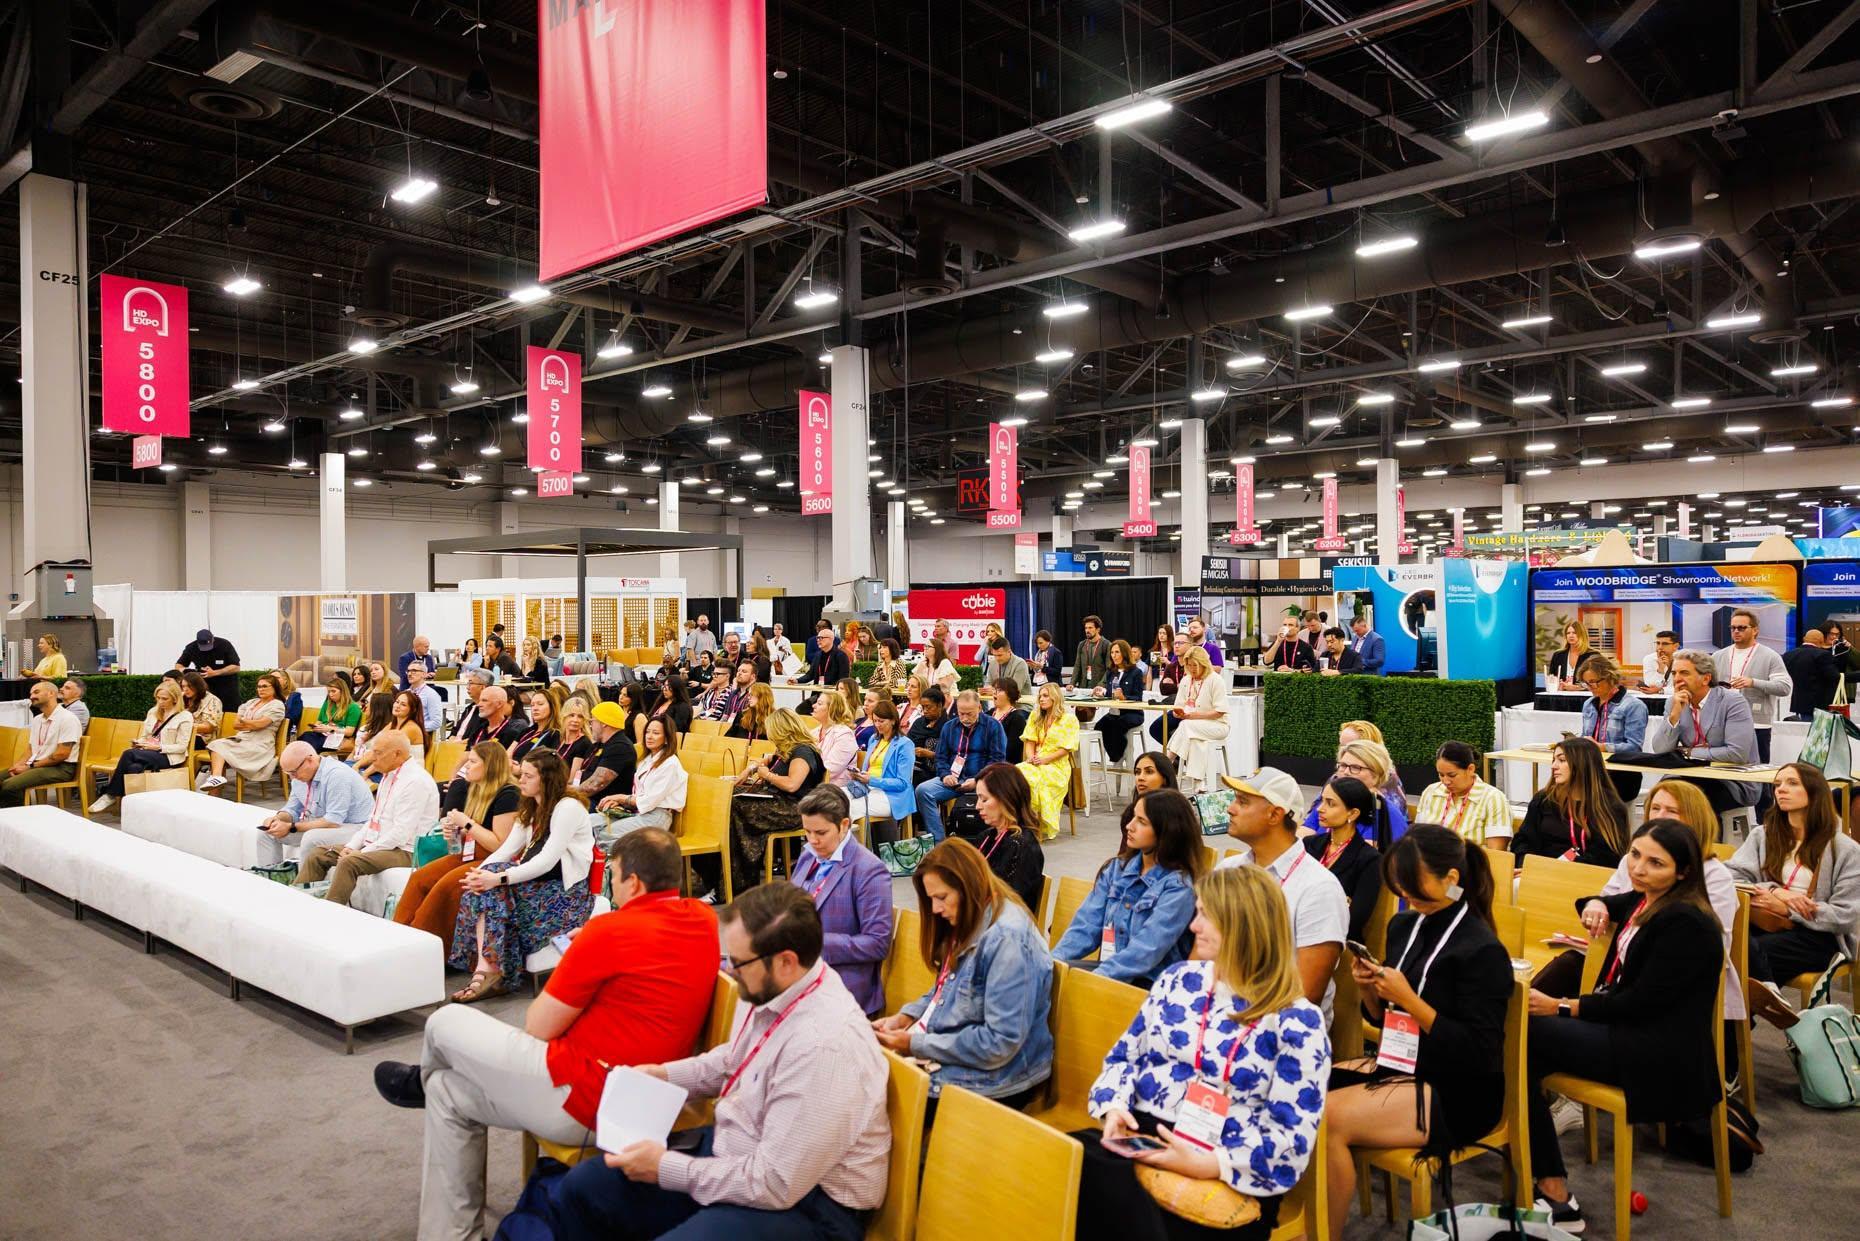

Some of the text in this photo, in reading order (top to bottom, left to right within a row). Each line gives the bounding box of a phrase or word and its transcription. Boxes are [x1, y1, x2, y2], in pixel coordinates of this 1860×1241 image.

[39, 270, 80, 286] CF25
[133, 309, 148, 318] HD
[133, 317, 160, 328] EXPO
[547, 372, 556, 380] HD
[138, 342, 156, 422] 5800
[550, 399, 561, 461] 5700
[135, 442, 158, 463] 5800
[542, 477, 568, 493] 5700
[806, 497, 832, 511] 5600
[991, 514, 1016, 525] 5500
[1127, 524, 1153, 534] 5400
[1234, 533, 1257, 542] 5300
[1468, 535, 1506, 546] Vintage
[1320, 540, 1342, 548] 5200
[1338, 557, 1372, 567] SEKISUI
[1207, 569, 1229, 579] MIGUSA
[1833, 572, 1856, 581] Join
[1554, 578, 1573, 586] Join
[1662, 575, 1721, 584] Showrooms
[1723, 574, 1771, 583] Network!
[1261, 585, 1286, 593] Durable
[1290, 584, 1318, 594] Hygienic
